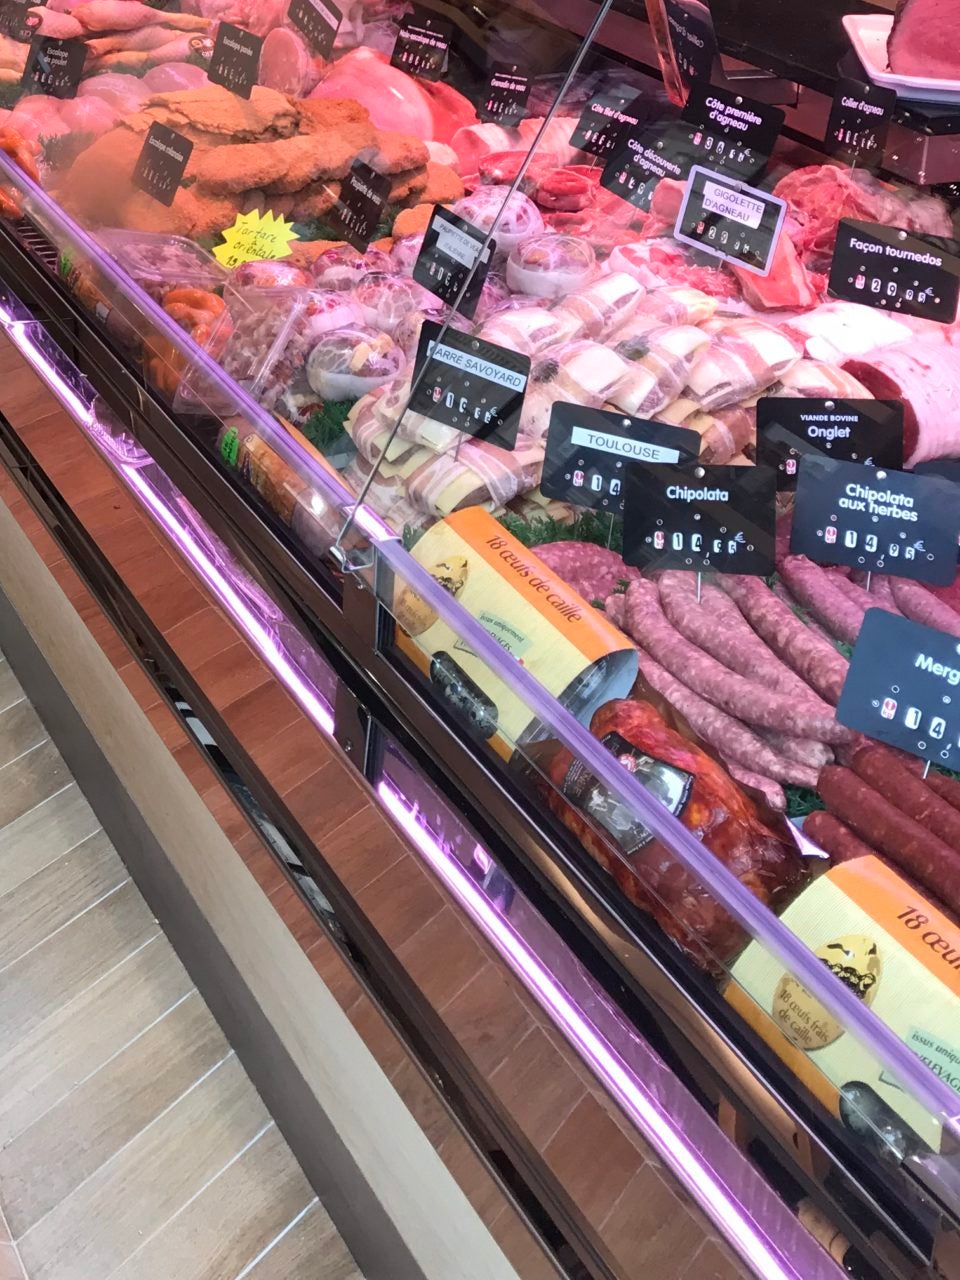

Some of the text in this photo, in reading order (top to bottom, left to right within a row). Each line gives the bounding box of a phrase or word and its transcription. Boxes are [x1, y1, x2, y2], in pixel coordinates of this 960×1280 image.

[46, 46, 69, 58] Escalope
[50, 55, 68, 66] poulet
[592, 103, 604, 114] Côte
[705, 96, 762, 125] Côte première
[841, 96, 884, 116] Collier d'agneau
[709, 111, 748, 132] d'agneau
[627, 138, 642, 151] Côte
[643, 146, 681, 175] découverte
[633, 155, 665, 177] d'agneau
[704, 198, 750, 222] D'AGNEAU
[714, 188, 763, 213] GIGOLETTE
[236, 221, 277, 243] Tartare
[233, 241, 276, 260] orientale
[850, 237, 943, 267] Façon tournedos
[463, 357, 522, 388] SAVOYARD
[800, 414, 859, 423] VIANDE BOVINE
[807, 425, 851, 441] Onglet
[587, 433, 661, 460] TOULOUSE
[666, 485, 729, 503] Chipolata
[845, 483, 914, 508] Chipolata
[838, 497, 919, 522] aux herbes
[486, 535, 506, 550] 18
[528, 575, 550, 594] de
[546, 594, 582, 624] caille
[897, 905, 929, 930] 18
[779, 1008, 791, 1023] de
[780, 989, 792, 1003] 18
[810, 1019, 829, 1042] frais
[911, 1030, 934, 1048] issus
